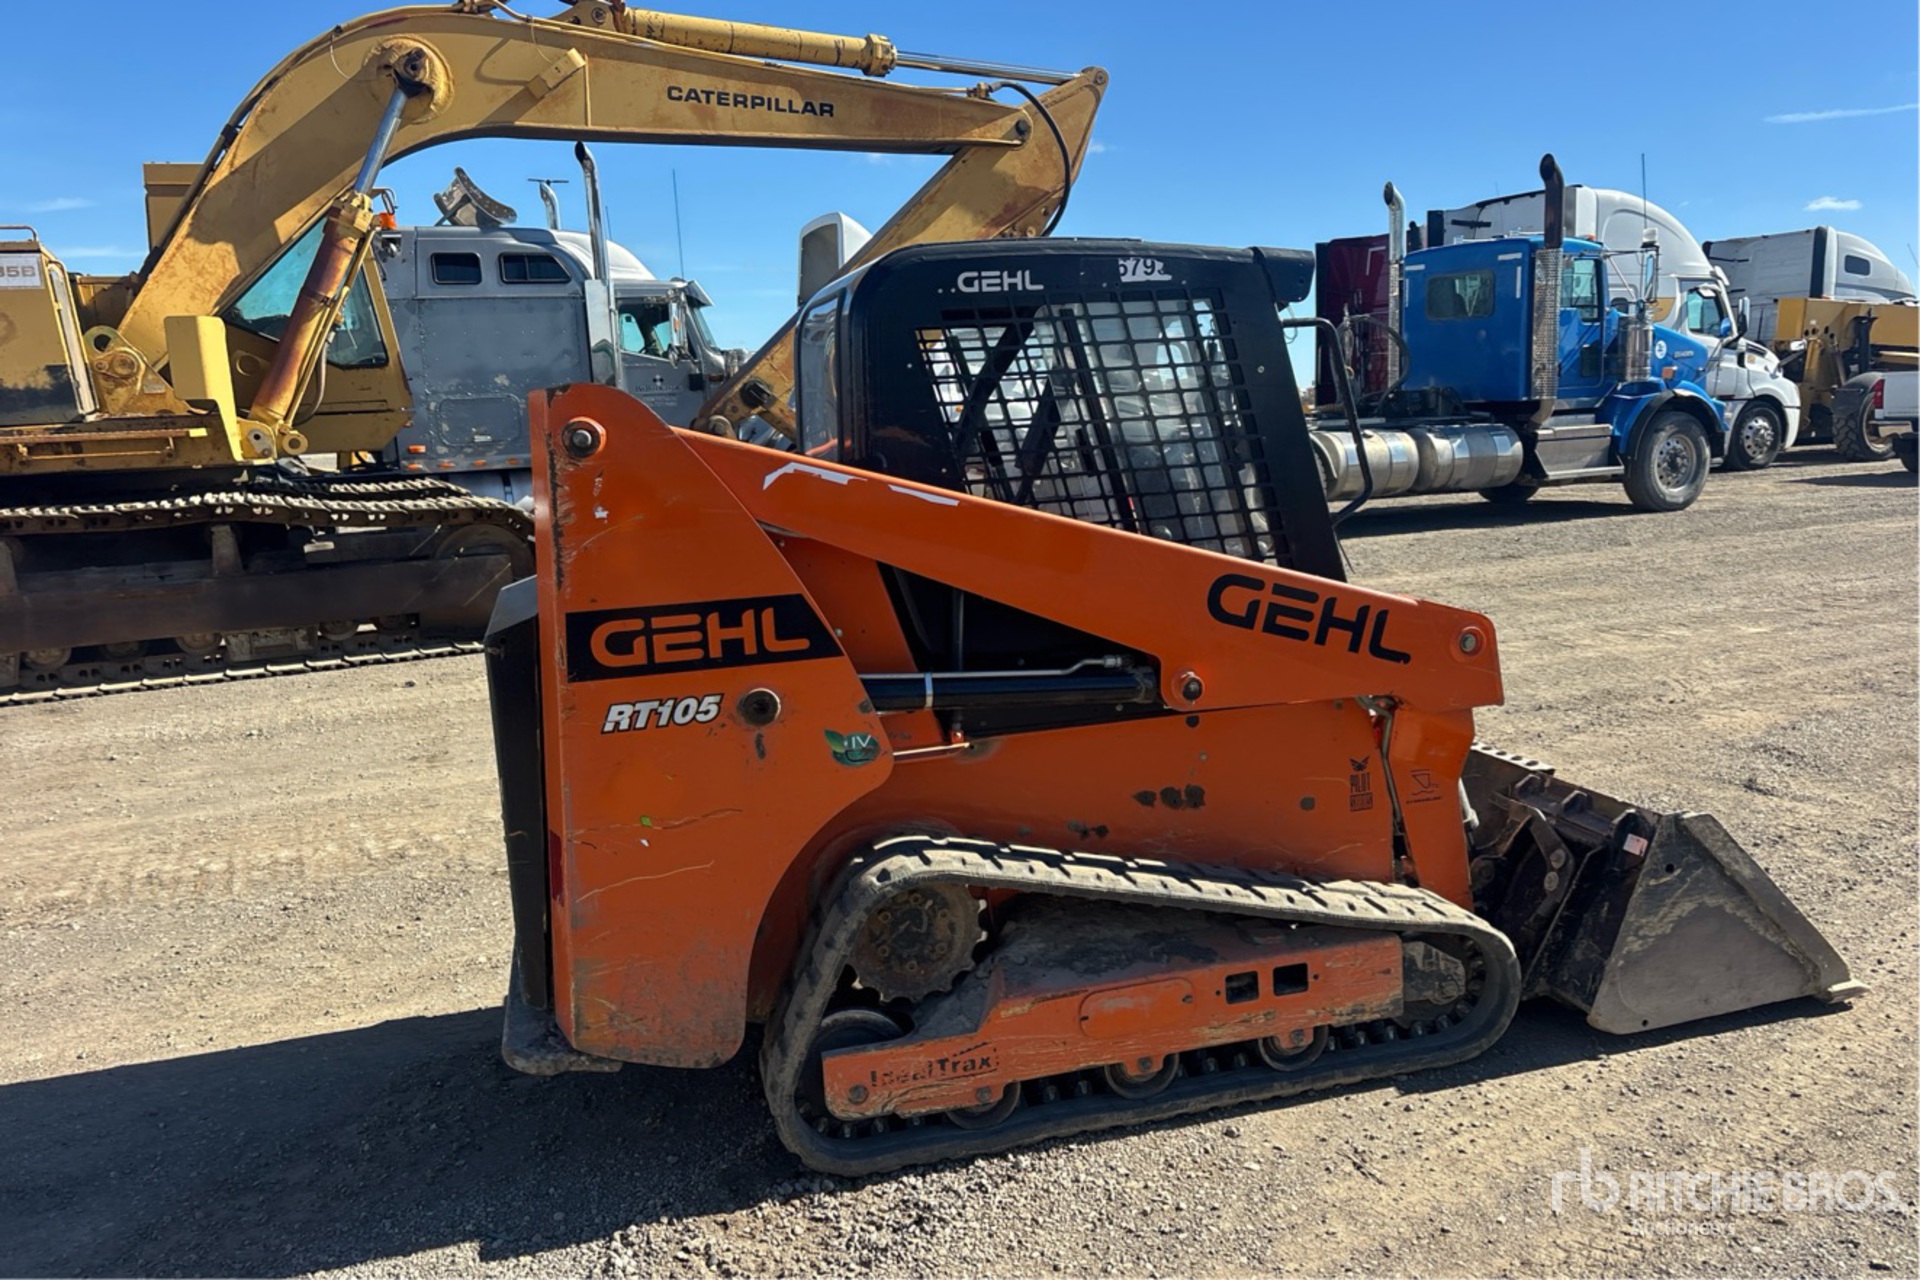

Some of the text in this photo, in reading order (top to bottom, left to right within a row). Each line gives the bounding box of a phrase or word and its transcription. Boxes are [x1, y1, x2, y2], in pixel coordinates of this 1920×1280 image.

[667, 85, 834, 117] CATERPILLAR
[957, 269, 1045, 293] GEHL
[590, 607, 811, 668] GEHL
[1207, 573, 1412, 665] GEHL
[601, 693, 724, 734] RT105
